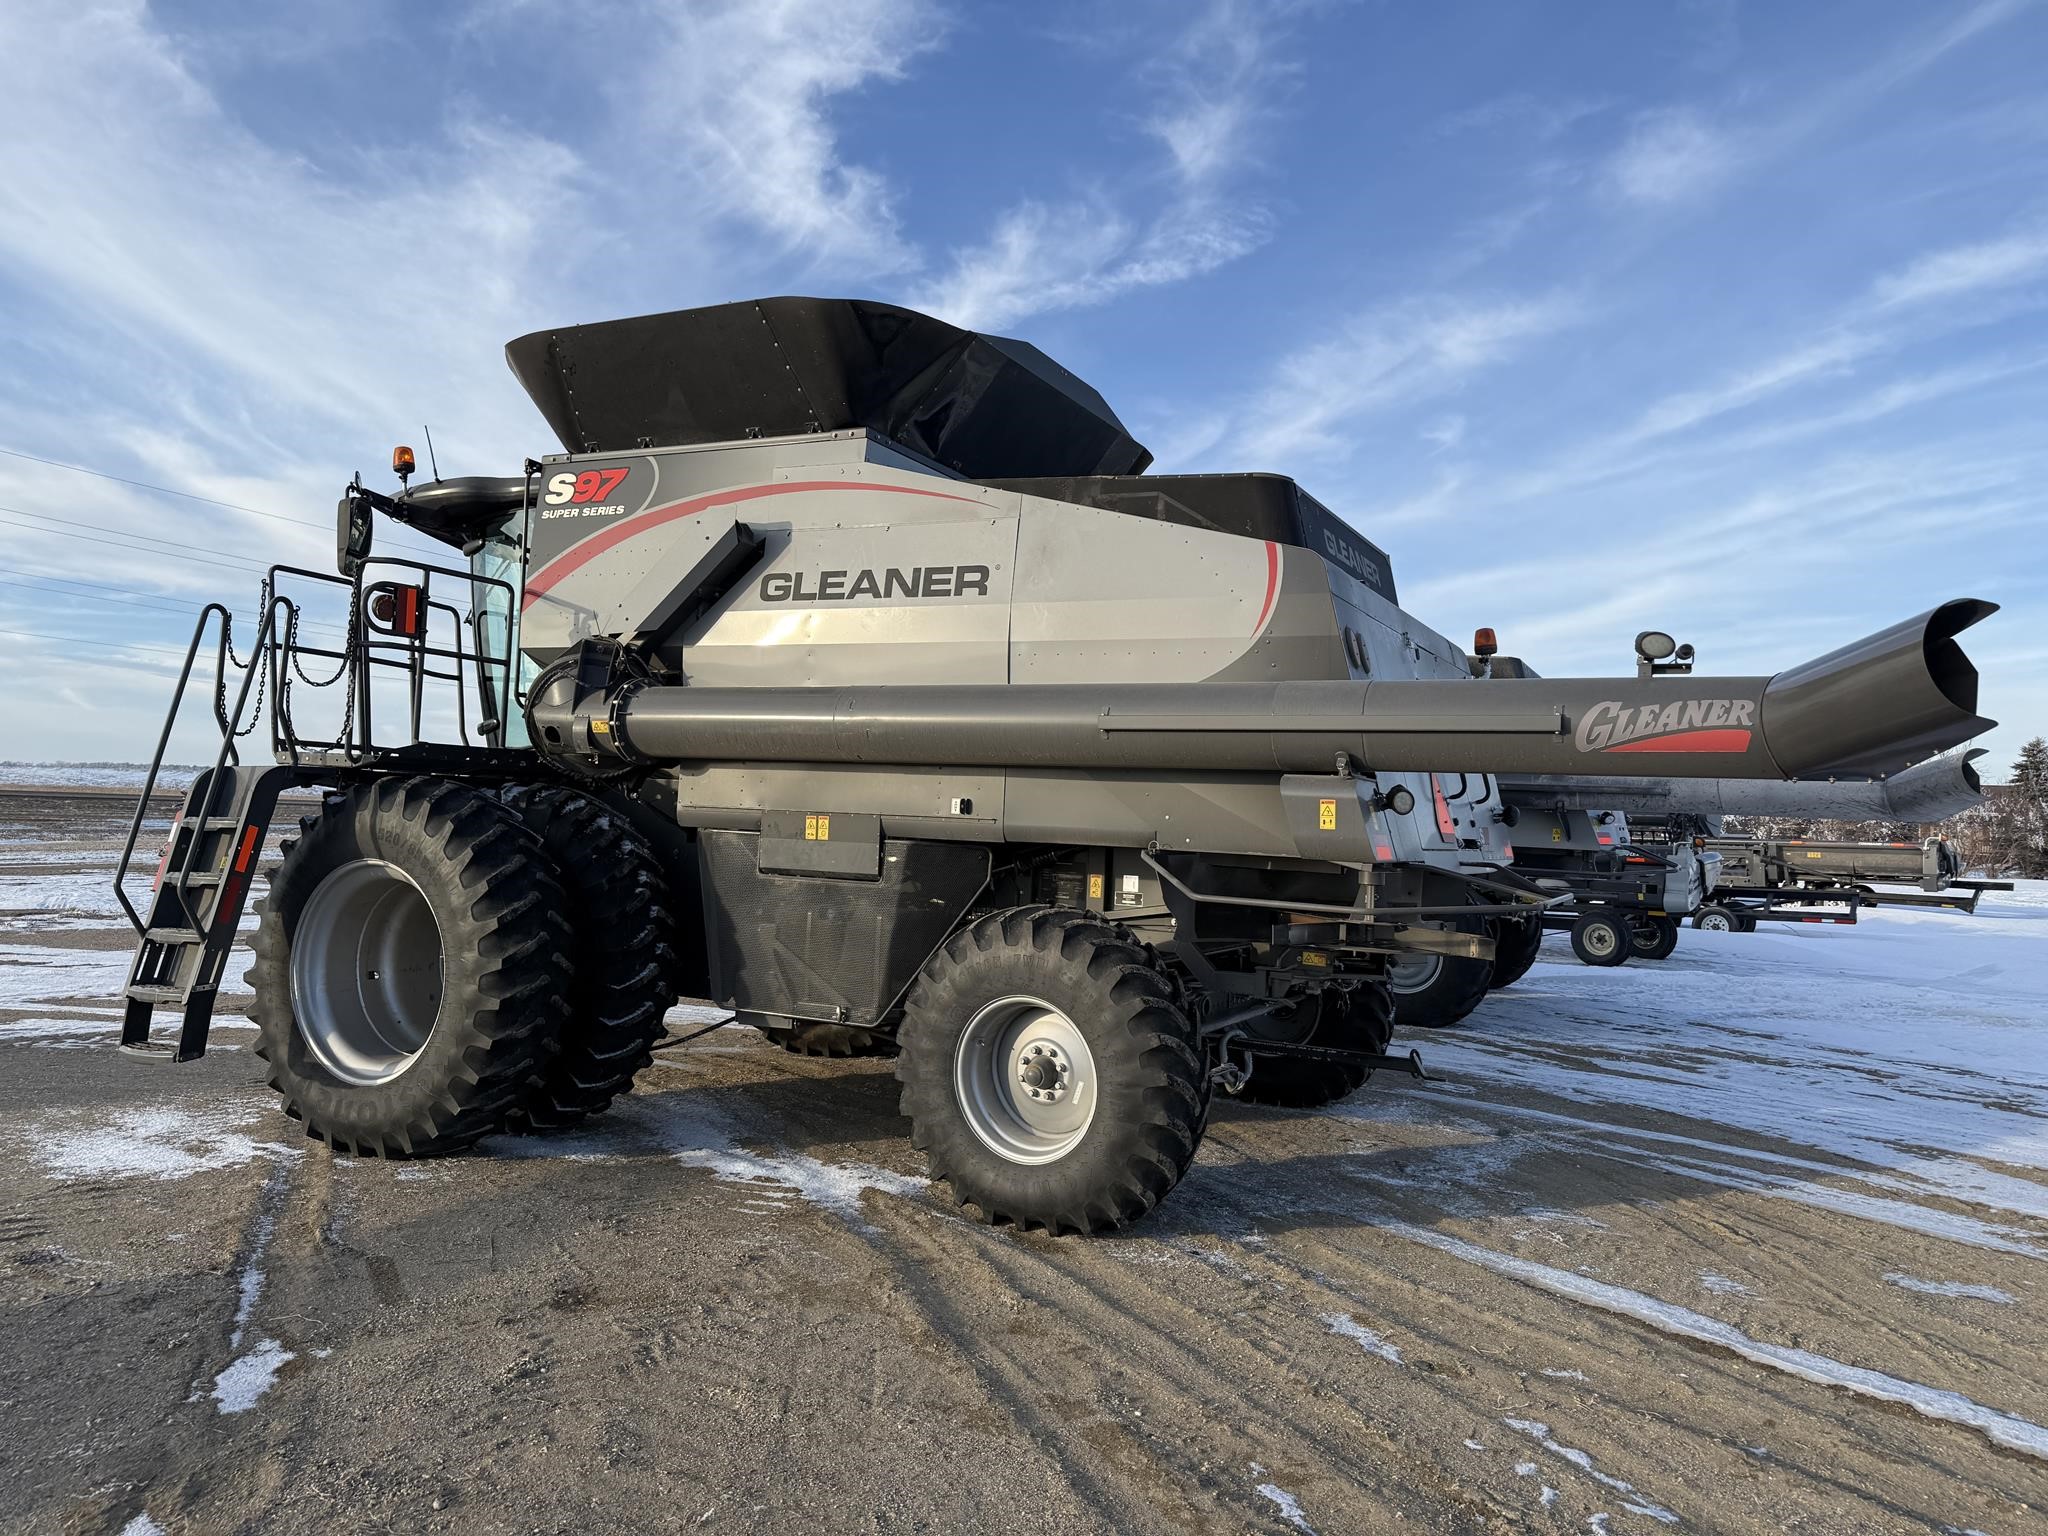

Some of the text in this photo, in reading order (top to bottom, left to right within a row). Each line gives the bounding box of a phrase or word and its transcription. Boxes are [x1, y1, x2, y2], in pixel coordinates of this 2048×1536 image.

[544, 467, 630, 505] S97
[541, 505, 625, 519] SUPER SERIES
[1323, 528, 1381, 588] GLEANER
[759, 564, 990, 602] GLEANER
[1575, 700, 1755, 752] GLEANER
